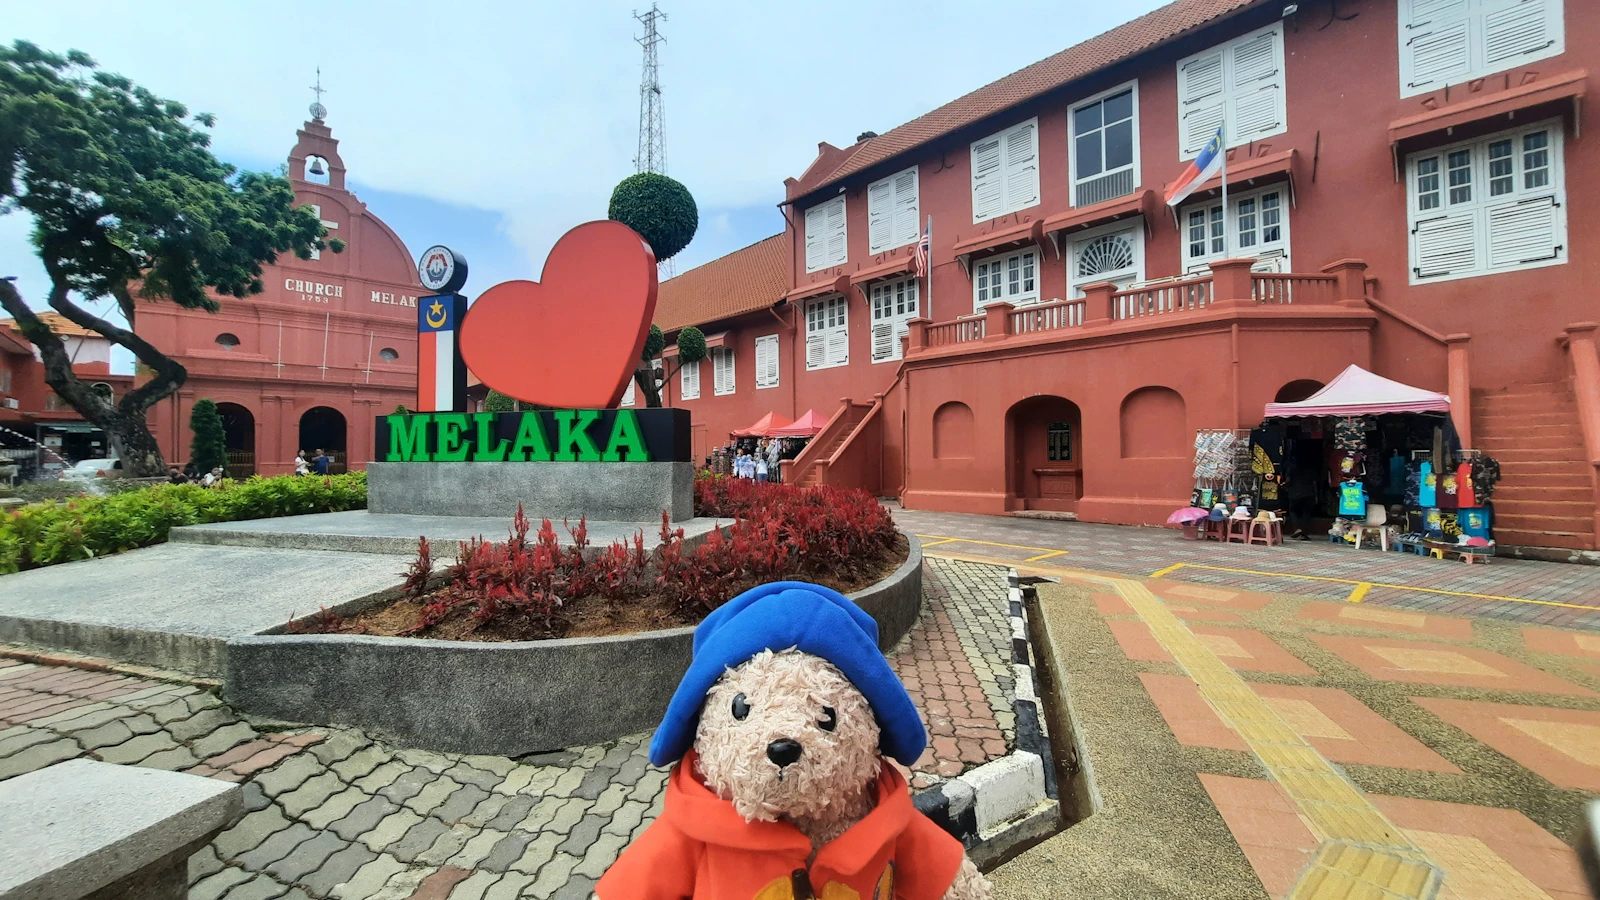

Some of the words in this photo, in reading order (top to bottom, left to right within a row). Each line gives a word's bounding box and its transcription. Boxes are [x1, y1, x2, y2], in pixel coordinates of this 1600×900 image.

[285, 279, 343, 297] CHURCH
[301, 294, 329, 304] 1753
[386, 409, 648, 461] MELAKA
